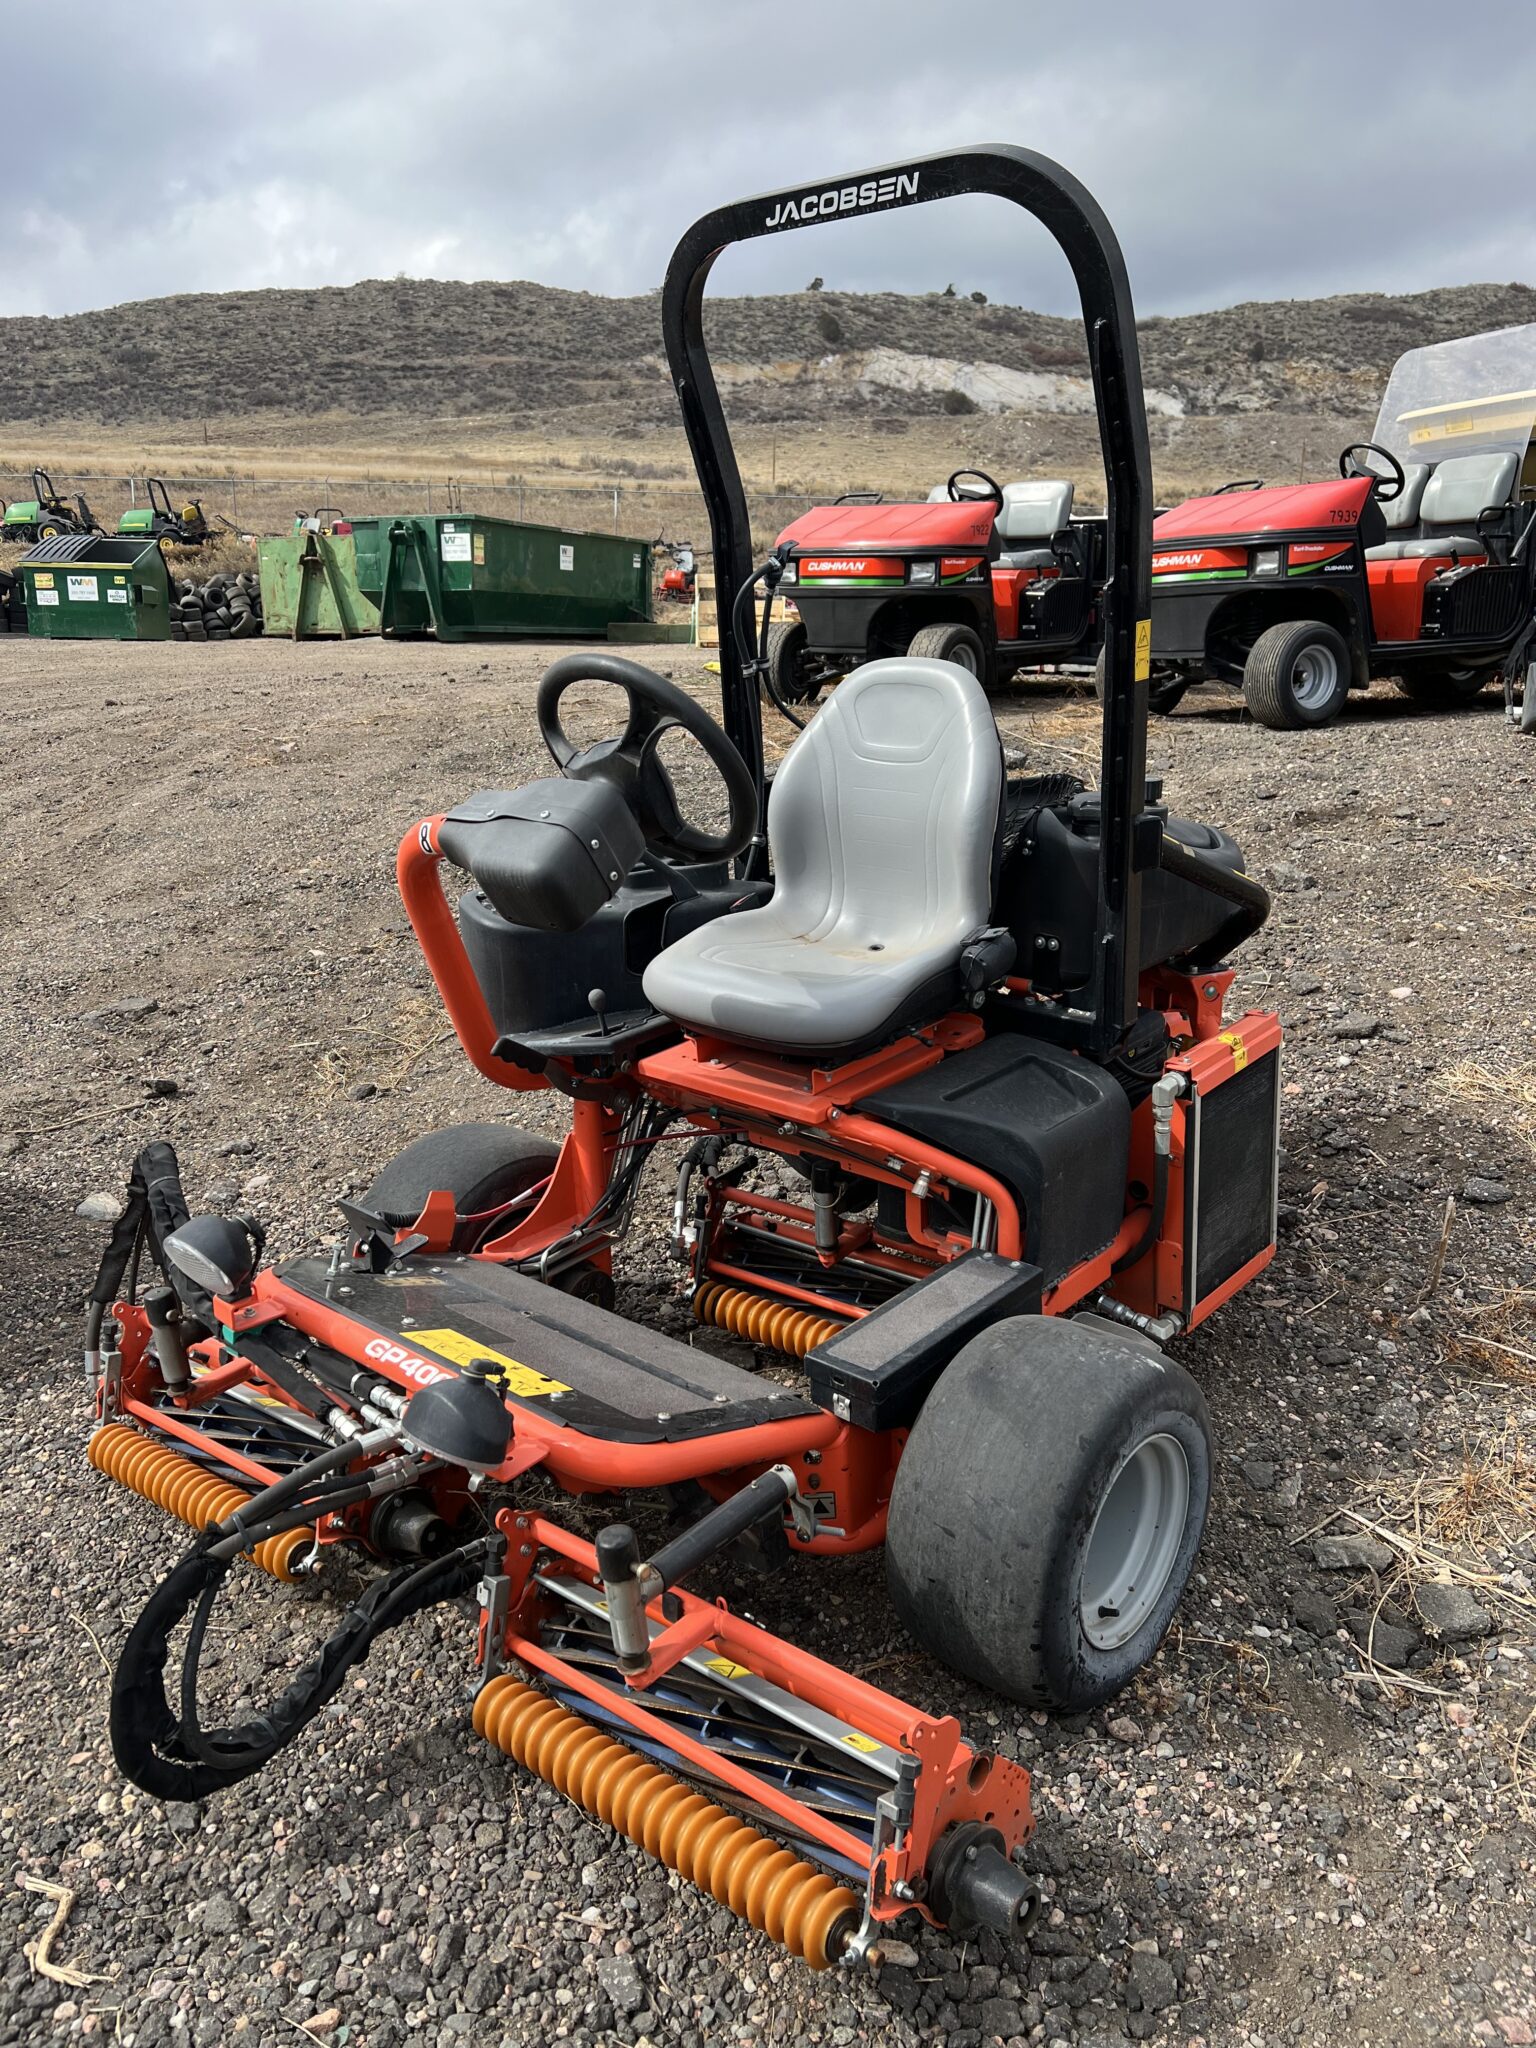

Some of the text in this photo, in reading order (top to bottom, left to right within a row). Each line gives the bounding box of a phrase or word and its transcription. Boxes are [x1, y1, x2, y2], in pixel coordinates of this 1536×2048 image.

[765, 171, 920, 227] JACOBSEN
[1329, 510, 1358, 523] 7939
[970, 524, 990, 536] 7922
[807, 561, 865, 571] CUSHMAN
[70, 578, 93, 586] WM
